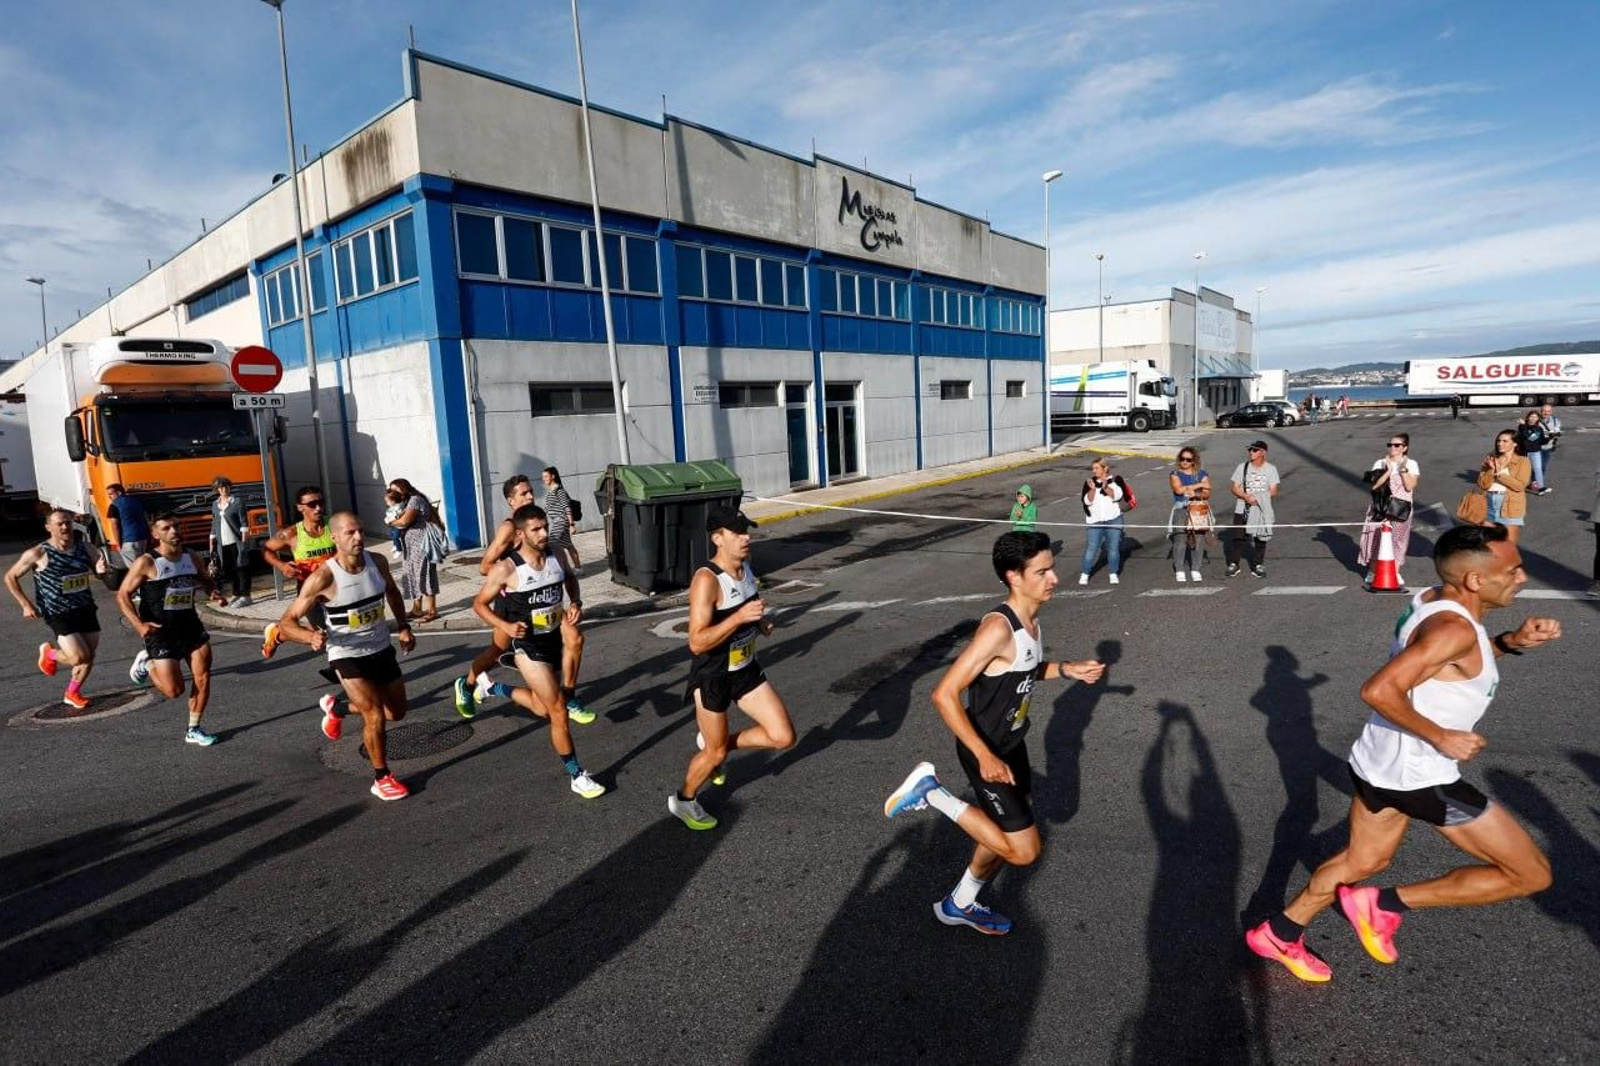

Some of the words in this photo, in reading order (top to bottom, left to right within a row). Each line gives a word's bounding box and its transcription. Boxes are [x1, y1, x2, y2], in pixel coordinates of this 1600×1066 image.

[240, 398, 247, 406] a
[252, 397, 267, 406] 50
[358, 609, 379, 624] 153
